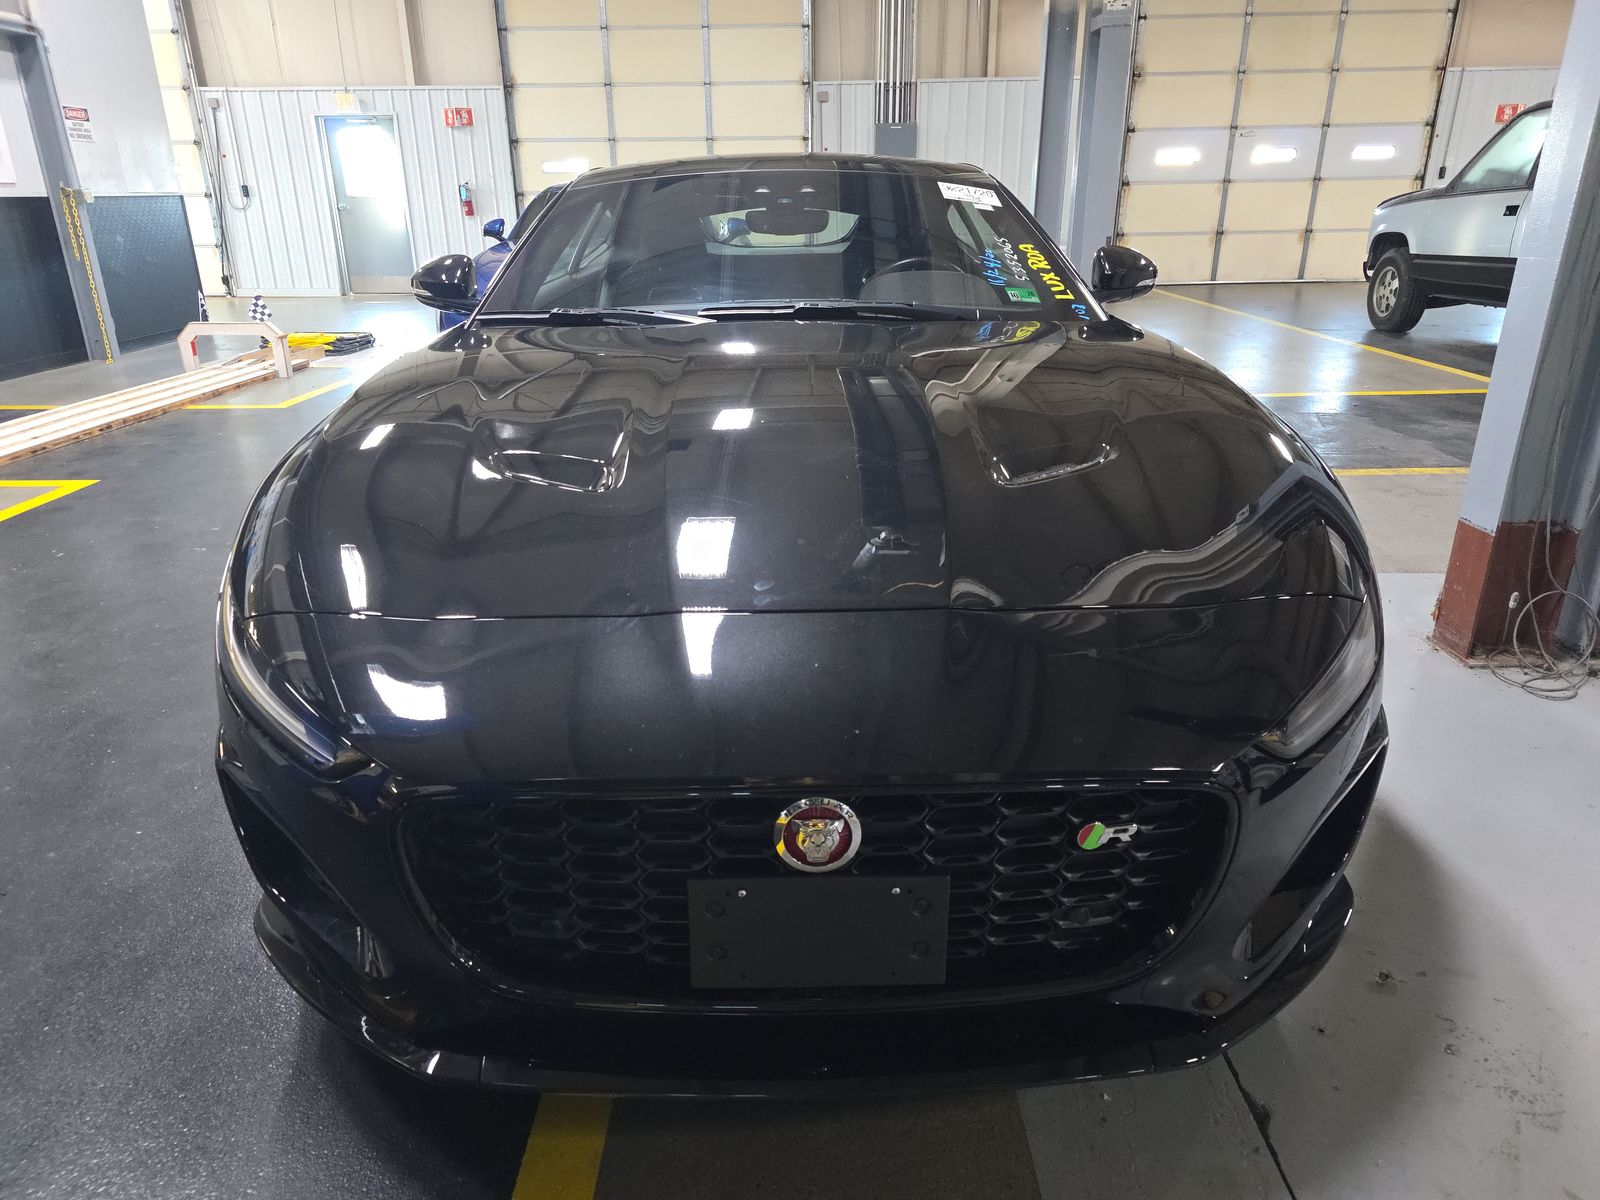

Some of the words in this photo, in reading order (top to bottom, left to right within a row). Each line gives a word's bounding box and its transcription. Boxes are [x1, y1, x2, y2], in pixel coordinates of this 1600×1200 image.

[65, 109, 86, 118] DANGER
[1040, 272, 1075, 300] LUX
[1097, 825, 1138, 845] R
